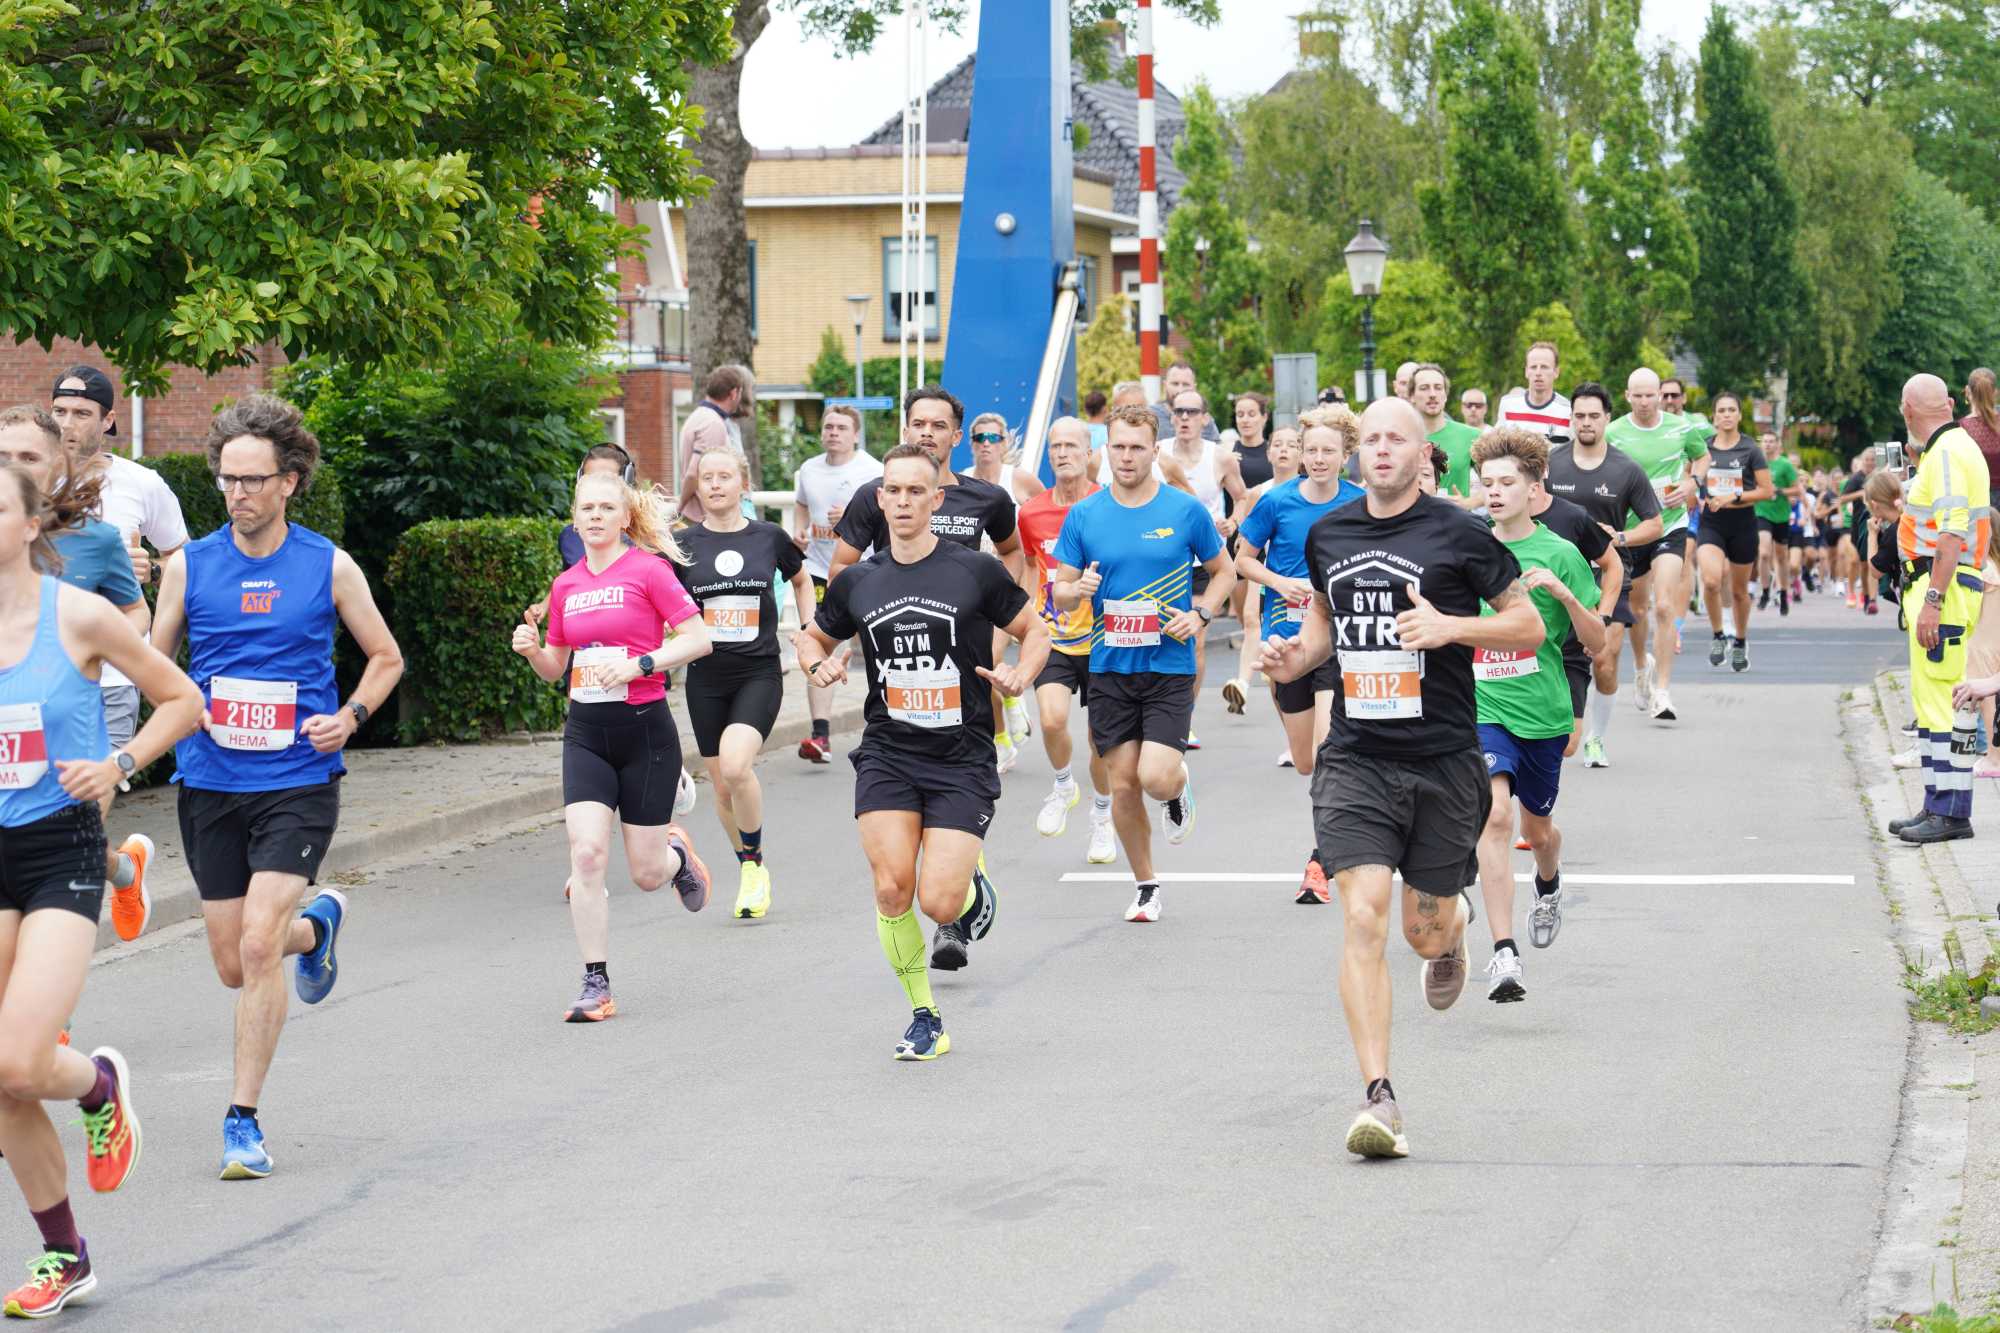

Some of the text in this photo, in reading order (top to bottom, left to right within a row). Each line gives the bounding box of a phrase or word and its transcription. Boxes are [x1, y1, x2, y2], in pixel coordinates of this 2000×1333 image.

[930, 524, 975, 536] PPINGEDAM
[953, 516, 979, 527] SPORT
[1326, 550, 1425, 575] LIVE A HEALTHY LIFESTYLE
[692, 578, 768, 594] Eemsdelta Keukens
[1354, 577, 1391, 588] Steendam
[862, 610, 877, 622] LIVE
[884, 596, 921, 610] HEALTHY
[921, 598, 957, 614] LIFESTYLE
[1353, 592, 1393, 613] GYM
[714, 610, 746, 627] 3240
[894, 621, 928, 632] Steendam
[1113, 616, 1145, 633] 2277
[1334, 616, 1402, 646] XTR
[894, 633, 931, 654] GYM
[1116, 637, 1143, 646] HEMA
[1487, 665, 1519, 677] HEMA
[1355, 674, 1401, 698] 3012
[902, 689, 944, 710] 3014
[227, 701, 276, 729] 2198
[229, 734, 268, 747] HEMA
